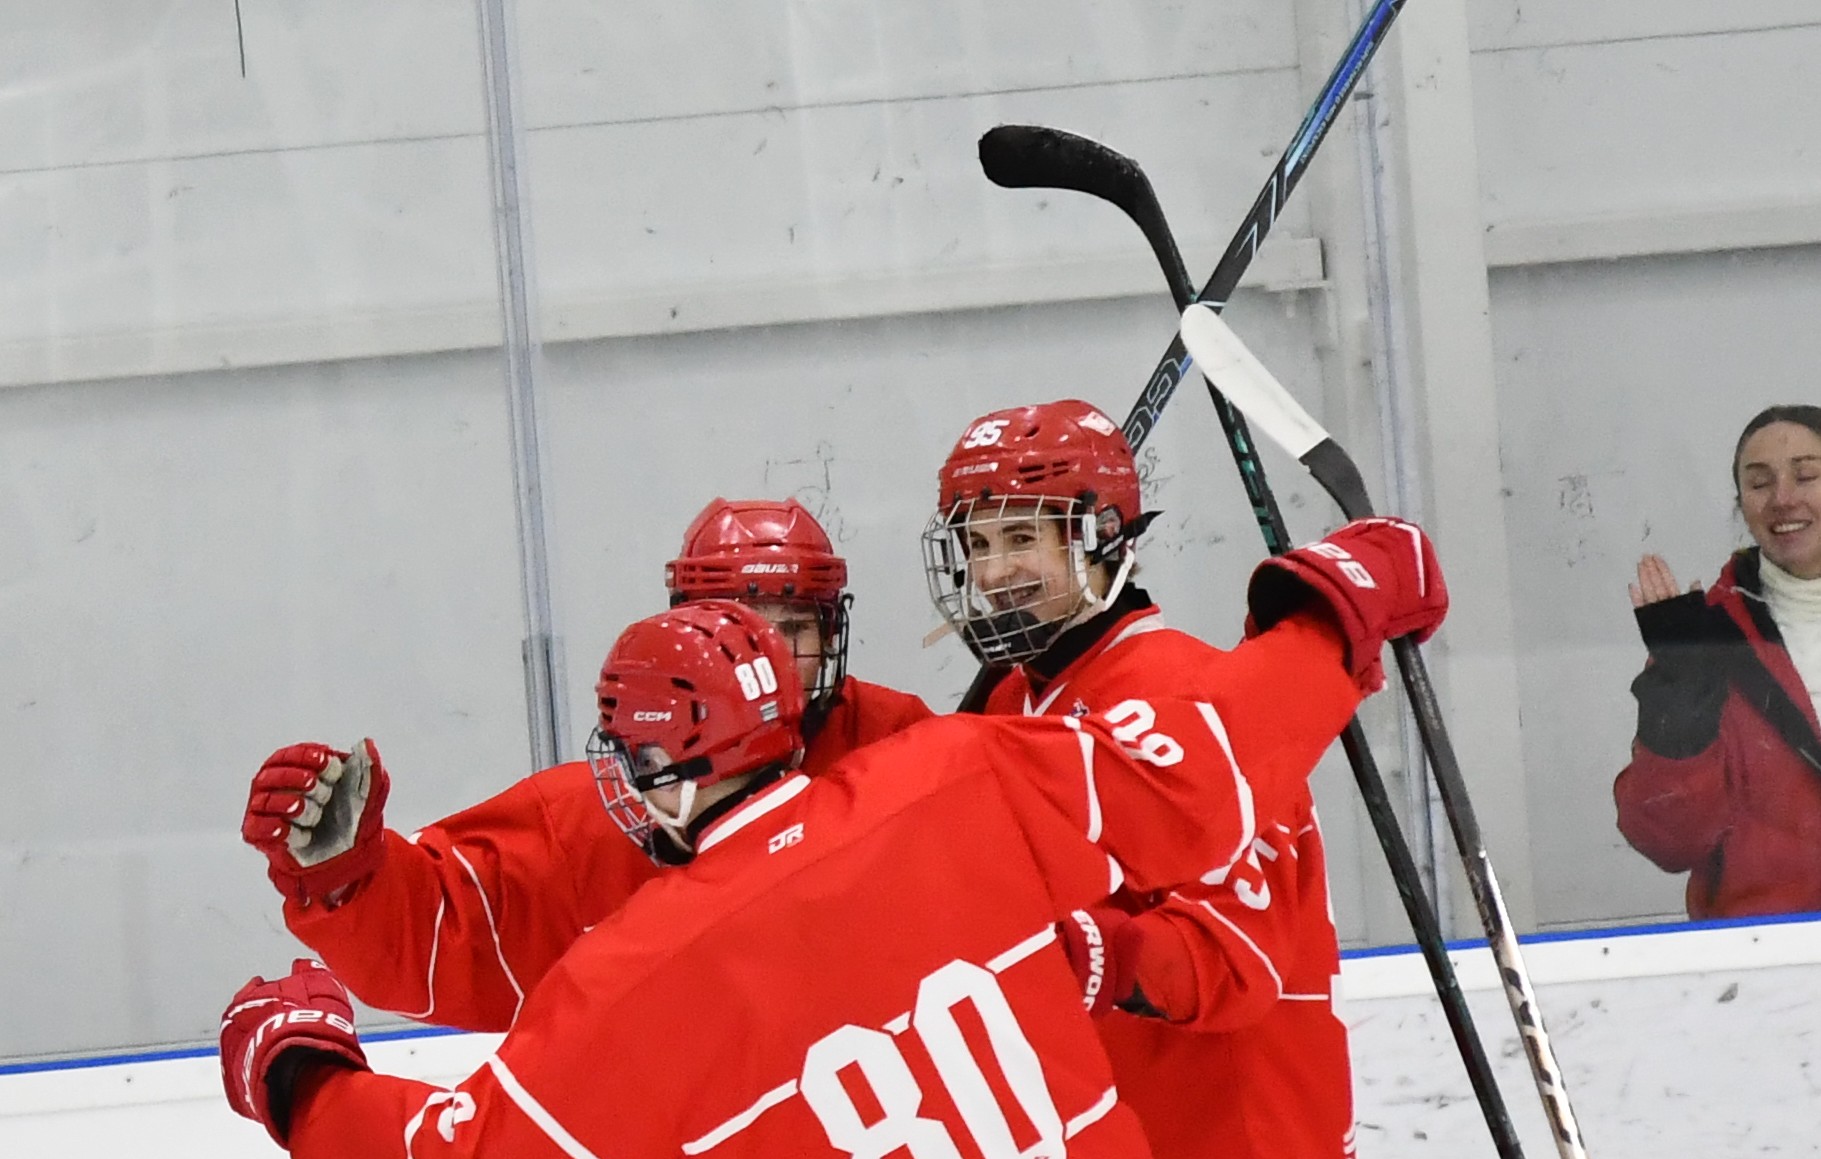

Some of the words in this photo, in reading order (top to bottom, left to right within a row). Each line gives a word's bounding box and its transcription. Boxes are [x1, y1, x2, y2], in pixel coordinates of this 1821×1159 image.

[963, 419, 1010, 449] 95
[734, 656, 778, 701] 80
[633, 711, 672, 722] CCM
